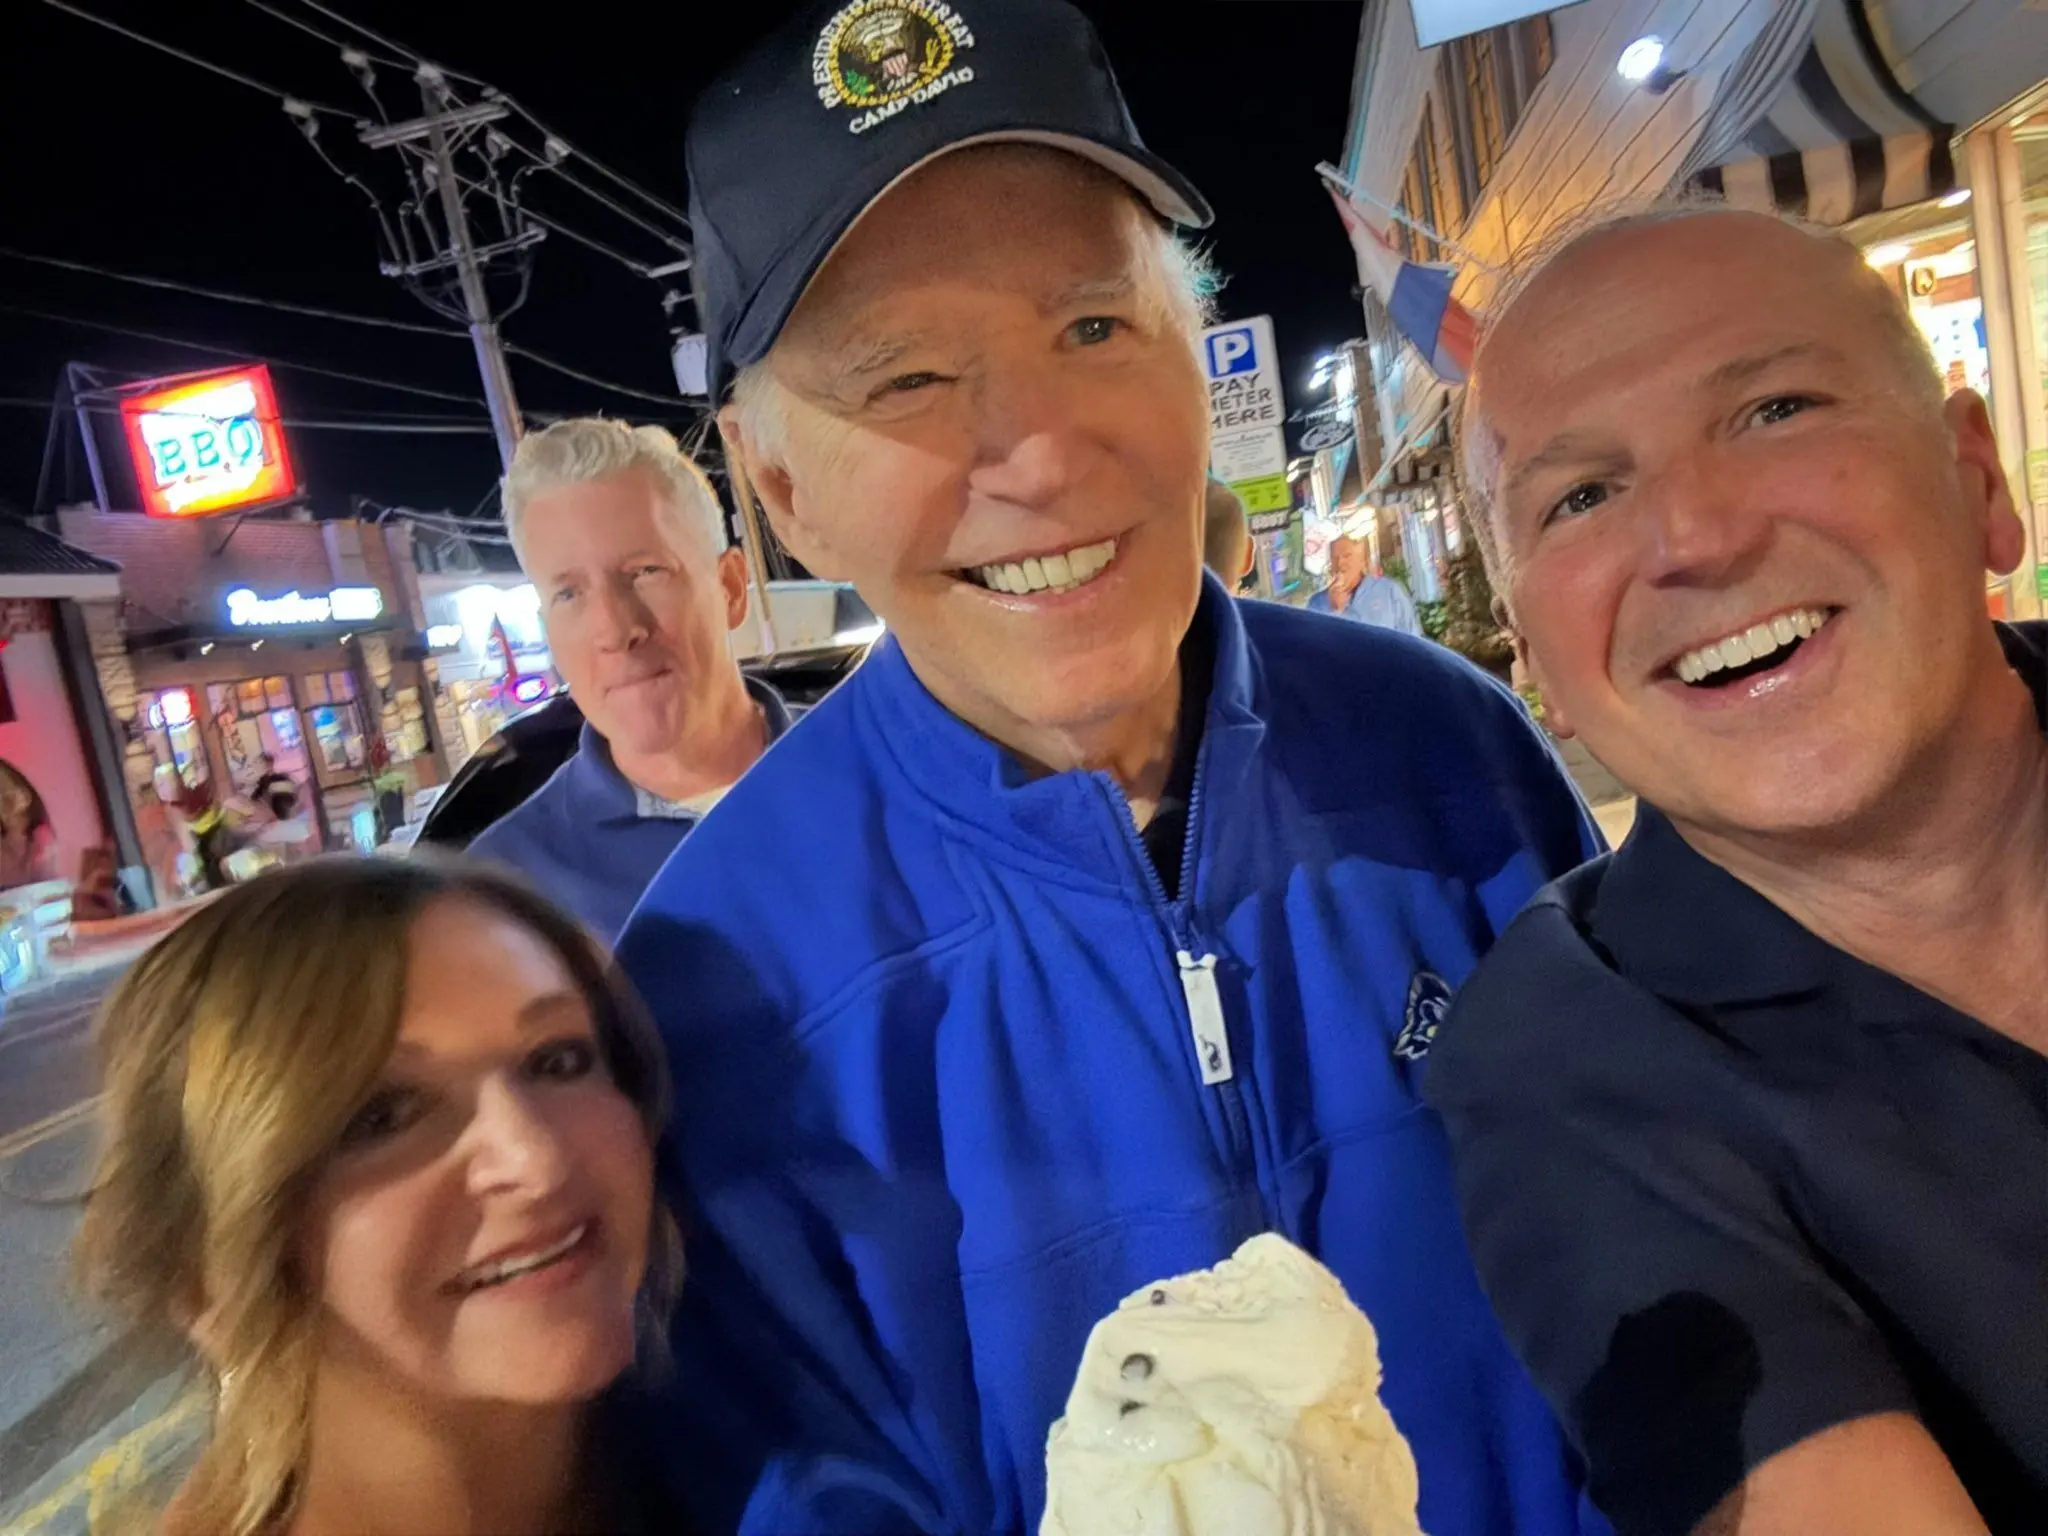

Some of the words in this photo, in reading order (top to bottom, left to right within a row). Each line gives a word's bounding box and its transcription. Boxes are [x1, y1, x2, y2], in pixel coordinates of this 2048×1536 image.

[849, 97, 909, 134] CAMP
[912, 66, 975, 104] DAVID
[1213, 333, 1250, 375] P
[1209, 372, 1261, 396] PAY
[154, 416, 256, 477] BBQ
